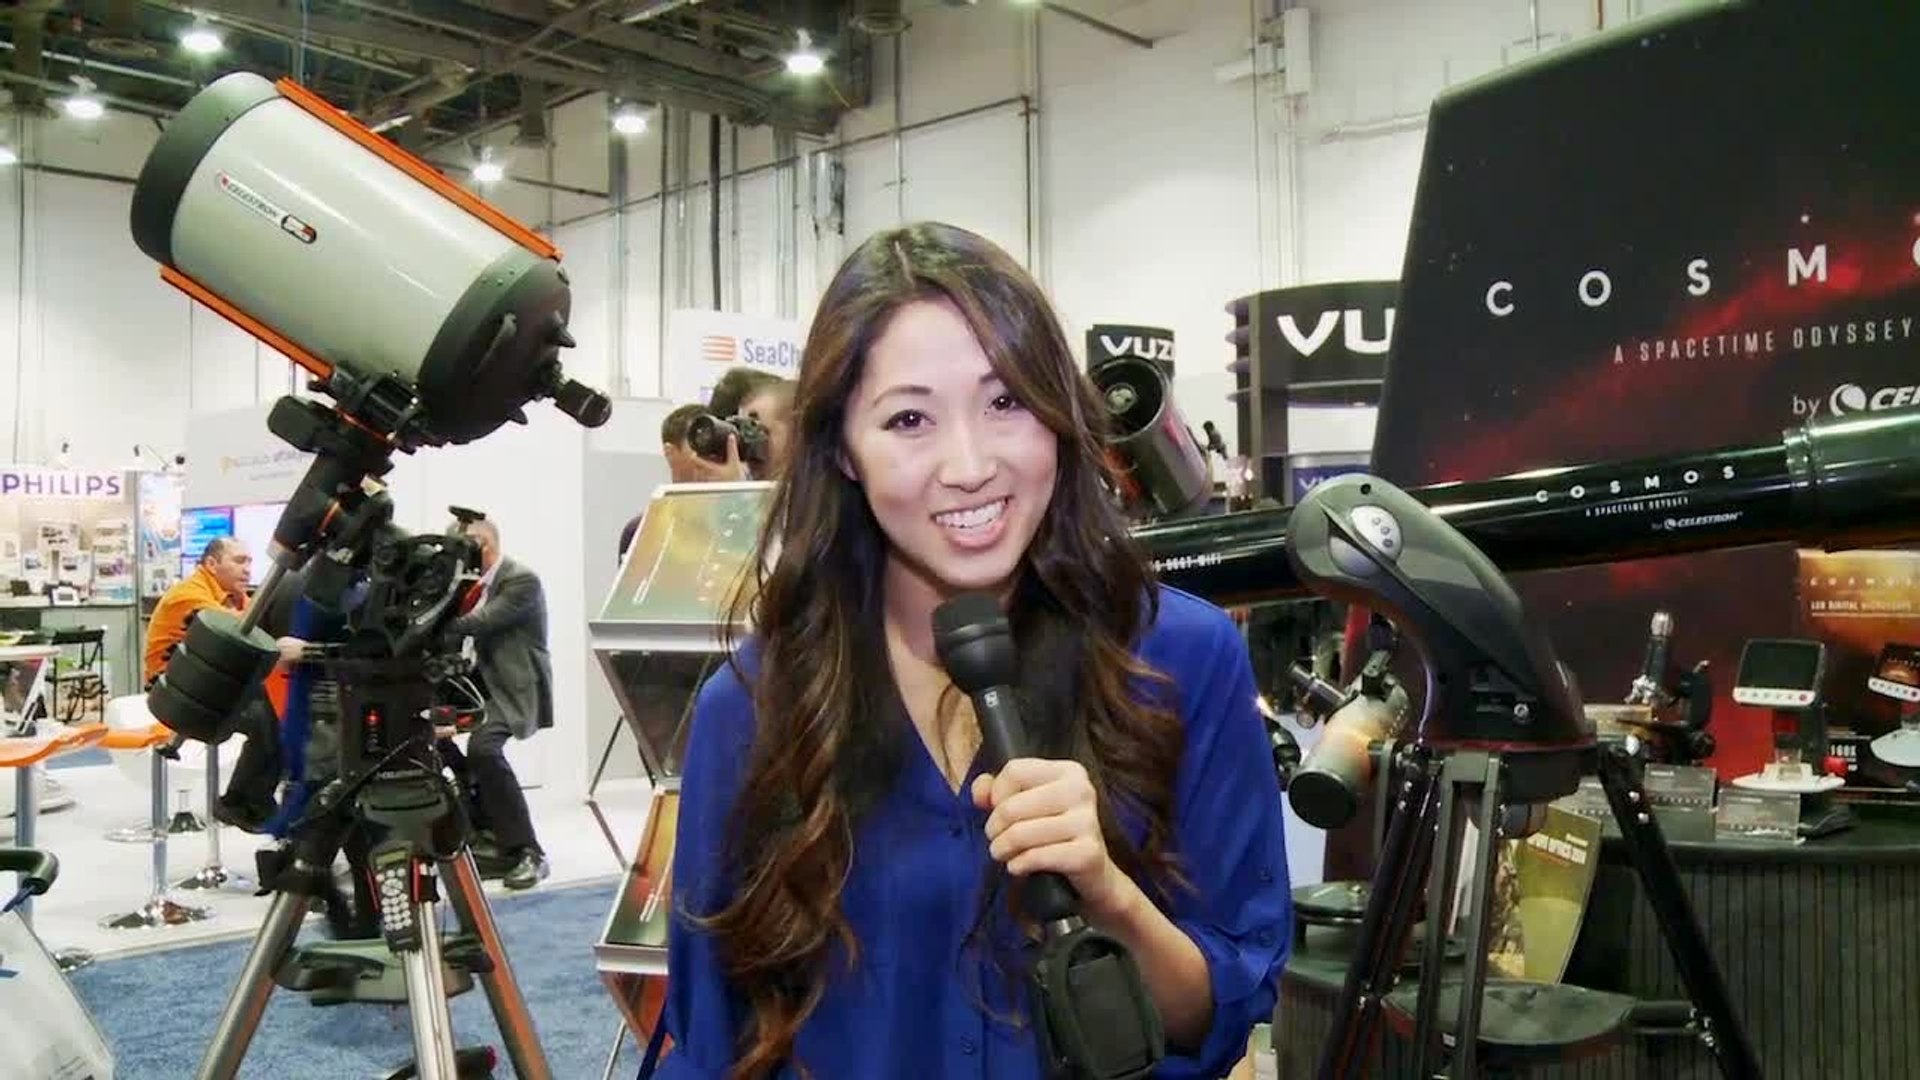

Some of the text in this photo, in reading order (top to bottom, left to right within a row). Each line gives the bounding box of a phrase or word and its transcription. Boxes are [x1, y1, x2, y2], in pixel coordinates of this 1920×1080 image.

[1485, 236, 1920, 317] COSM
[1614, 317, 1912, 363] A SPACETIME ODYSSEY
[1793, 396, 1821, 419] by
[2, 474, 120, 495] PHILIPS
[1536, 465, 1735, 503] COSMOS
